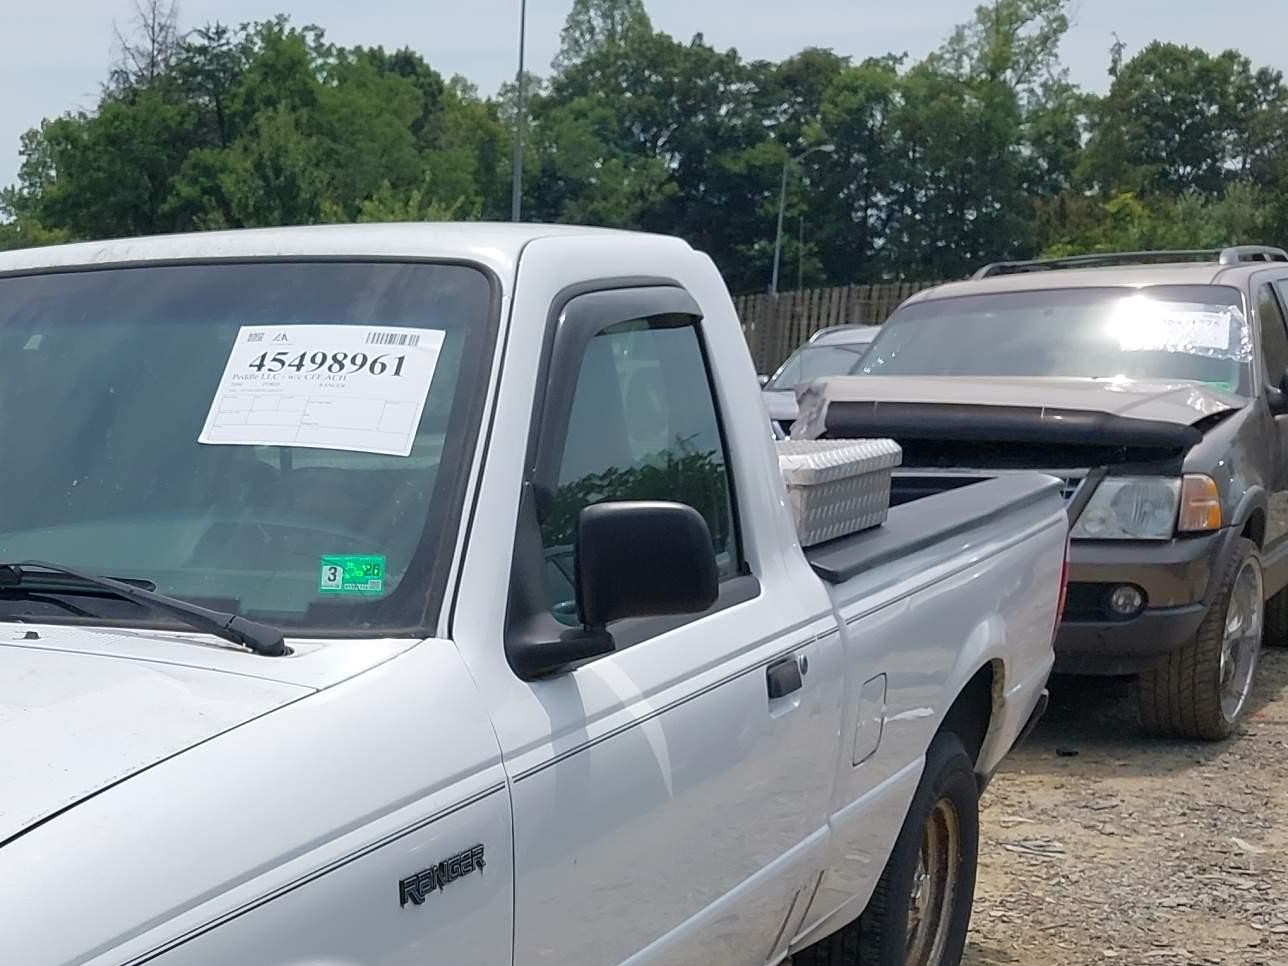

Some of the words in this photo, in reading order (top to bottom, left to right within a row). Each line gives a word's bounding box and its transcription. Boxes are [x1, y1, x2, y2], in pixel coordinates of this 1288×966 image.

[248, 351, 407, 377] 45498961
[327, 566, 337, 582] 3
[399, 843, 487, 908] RANGER
